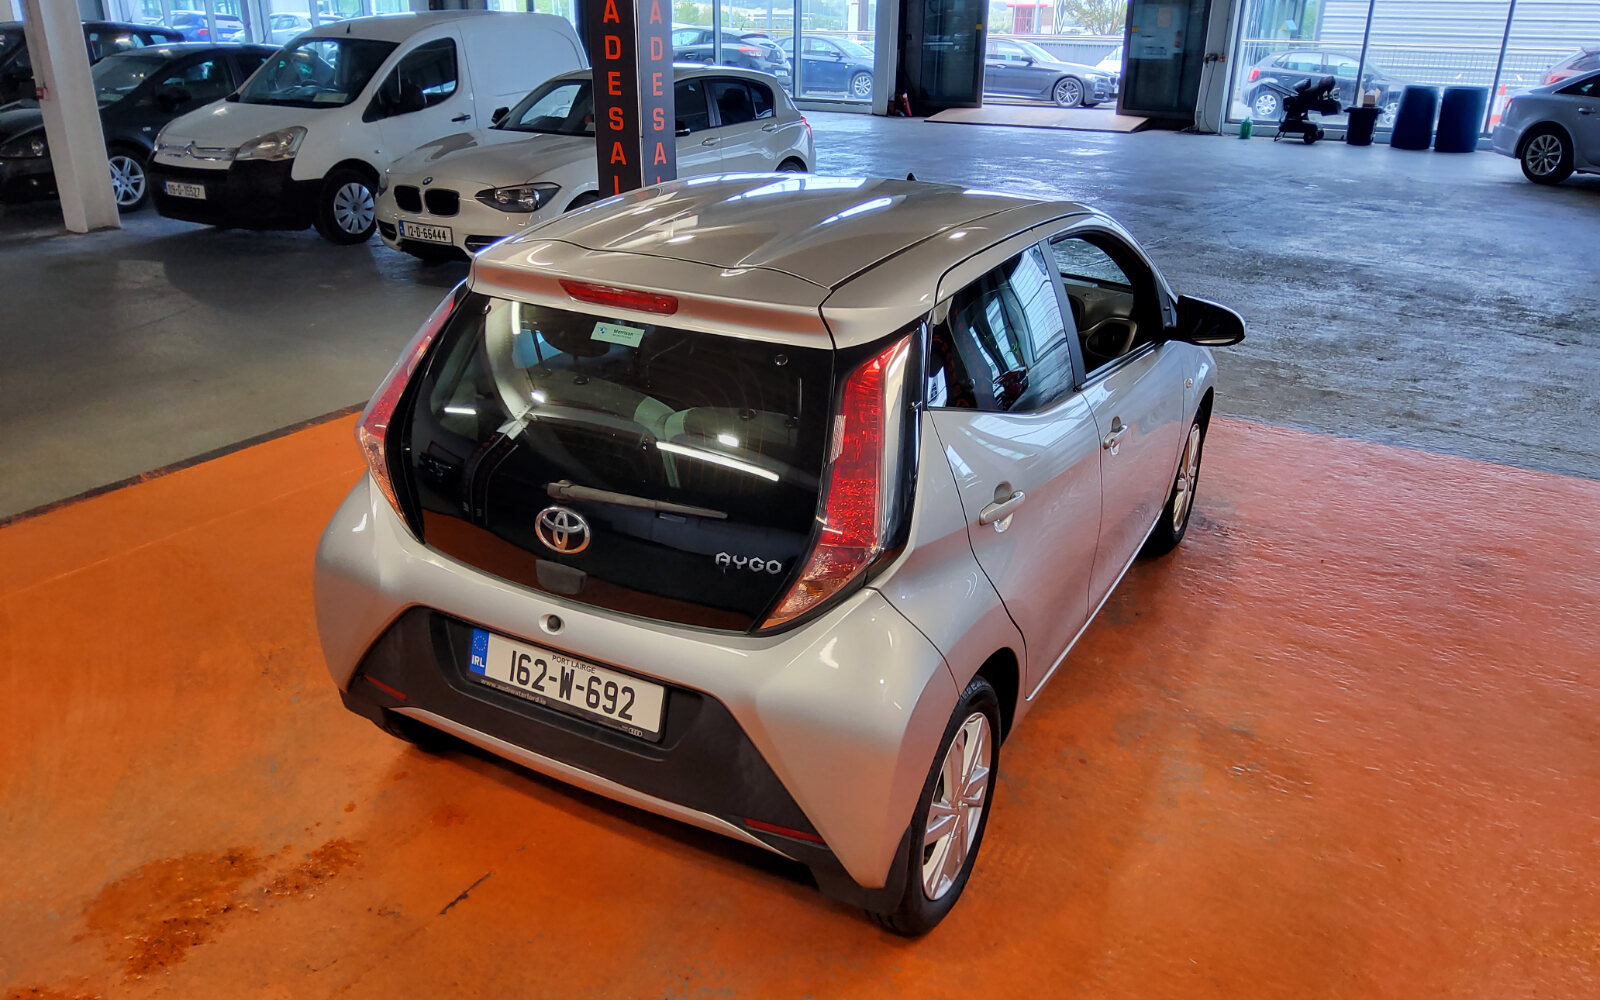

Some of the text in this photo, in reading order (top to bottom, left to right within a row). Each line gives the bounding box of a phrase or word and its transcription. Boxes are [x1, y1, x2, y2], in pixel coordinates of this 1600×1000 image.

[715, 551, 782, 574] AYGO
[471, 654, 485, 668] IRL
[552, 654, 570, 666] PORT
[509, 650, 635, 721] 162-W-692
